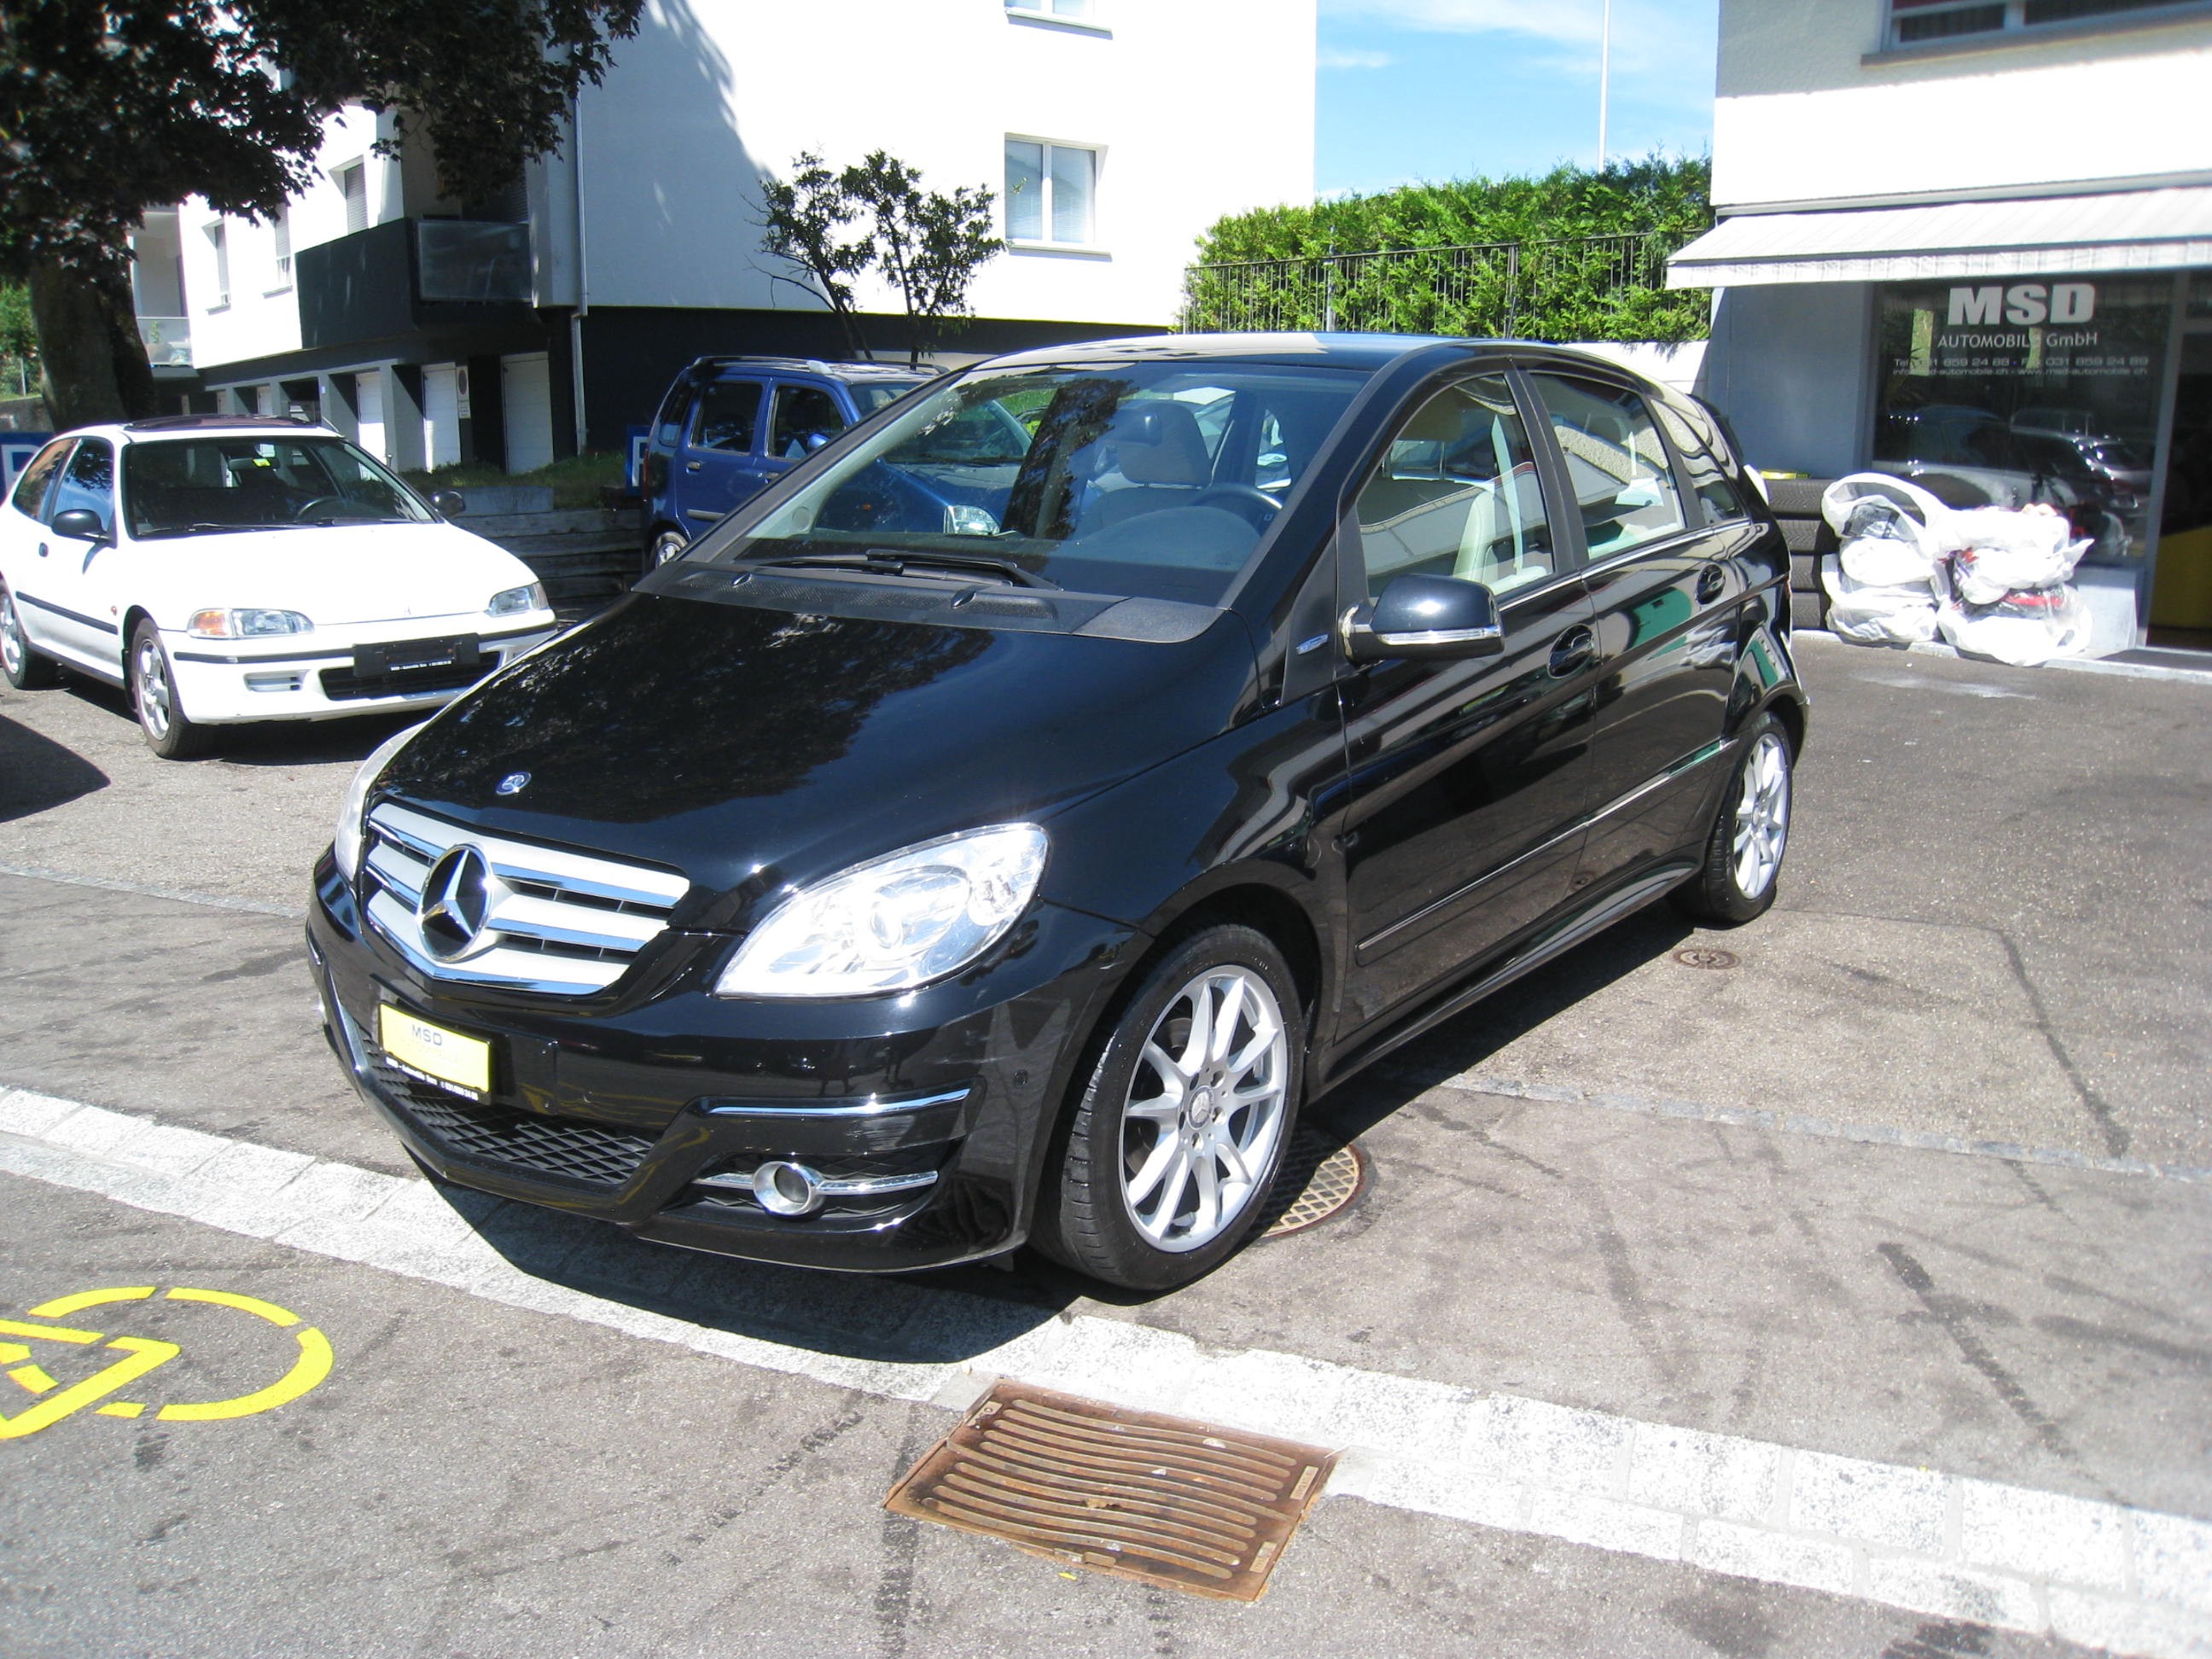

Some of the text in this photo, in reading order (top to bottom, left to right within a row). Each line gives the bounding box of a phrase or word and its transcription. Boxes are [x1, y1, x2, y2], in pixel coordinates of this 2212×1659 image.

[1948, 283, 2096, 325] MSD
[1937, 332, 2098, 348] AUTOMOBIL GmbH
[1971, 357, 1988, 367] 24
[411, 1024, 443, 1046] MSD
